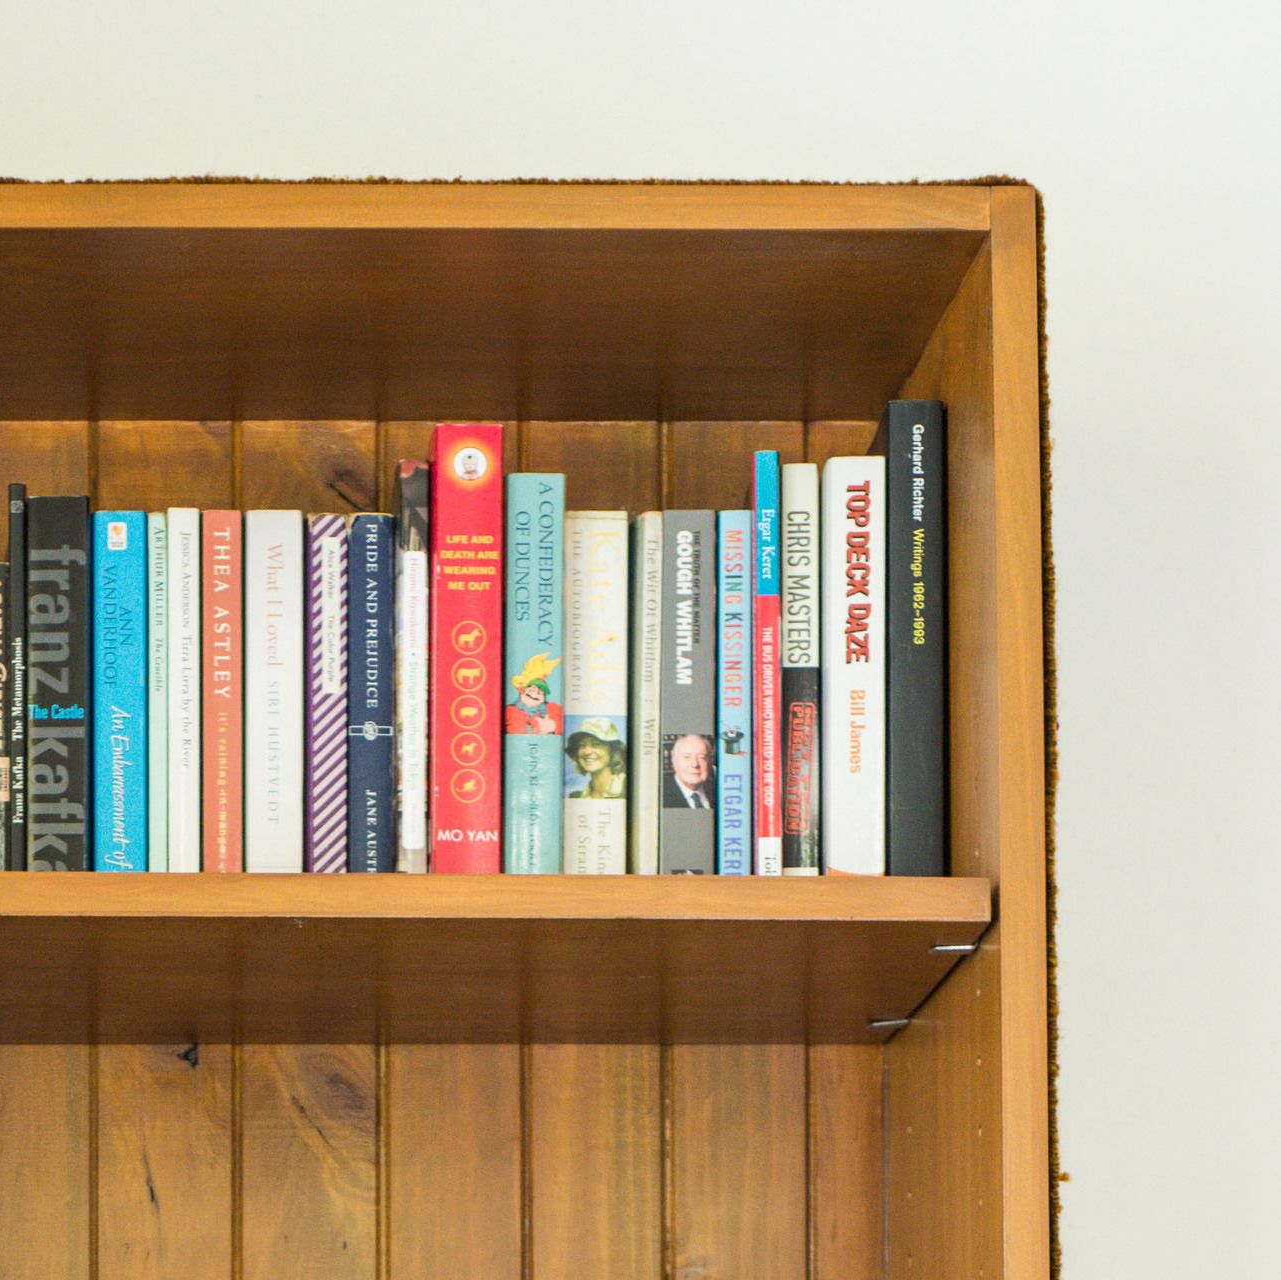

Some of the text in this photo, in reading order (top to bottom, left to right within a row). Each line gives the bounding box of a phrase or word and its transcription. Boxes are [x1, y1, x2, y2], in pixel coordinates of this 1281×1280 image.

[440, 551, 499, 559] DEATH ARE
[443, 567, 495, 575] WEARING
[446, 535, 493, 544] LIFE AND
[515, 511, 530, 621] OF DUNCES
[538, 481, 553, 646] A CONFEDERACY
[845, 480, 872, 664] TOP DECK DAZE
[366, 524, 377, 708] PRIDE AND PREJUDICE
[448, 582, 491, 590] ME OUT
[676, 530, 692, 685] GOUGH WHITLAM
[848, 690, 864, 774] Bill James
[437, 830, 497, 842] MO YAN
